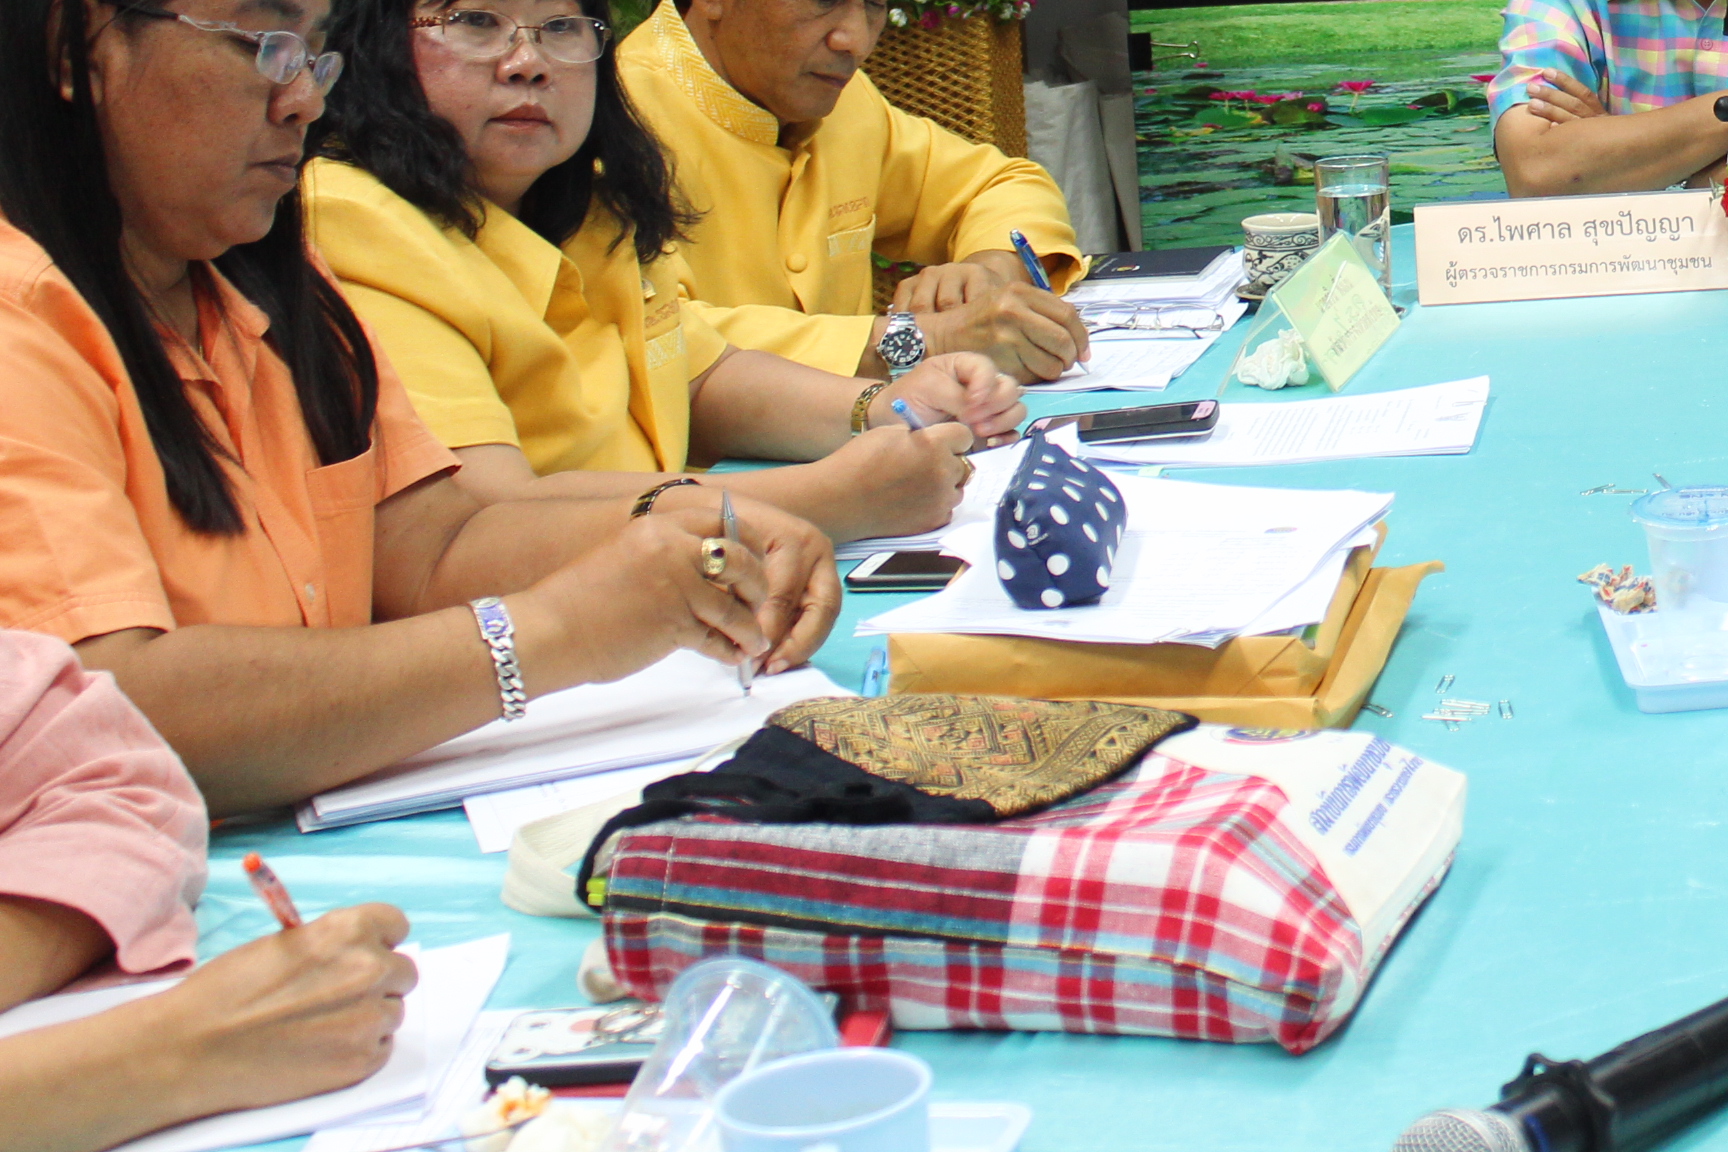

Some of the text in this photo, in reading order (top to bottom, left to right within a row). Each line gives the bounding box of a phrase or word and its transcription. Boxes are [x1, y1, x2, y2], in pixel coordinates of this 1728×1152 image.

[1457, 210, 1695, 246] ดร.ไพศาล สุขปัญญา
[1445, 254, 1713, 288] ผู้ตรวจราชการกรมการพัฒนาชุมชน
